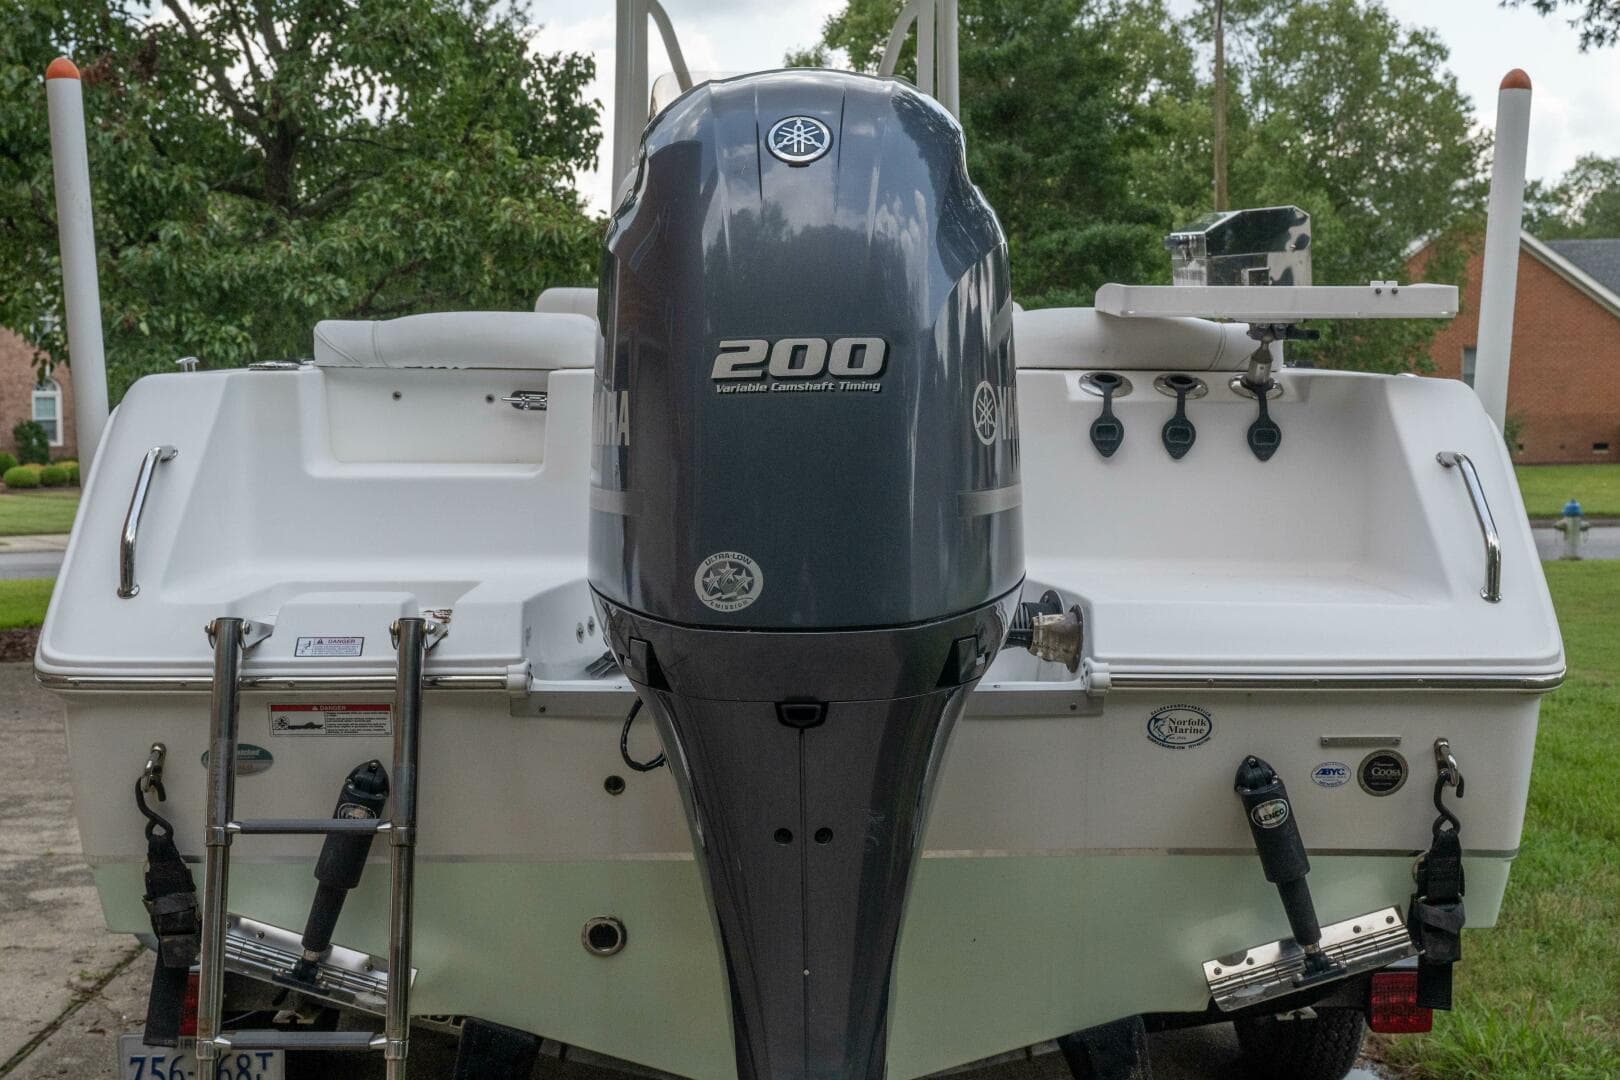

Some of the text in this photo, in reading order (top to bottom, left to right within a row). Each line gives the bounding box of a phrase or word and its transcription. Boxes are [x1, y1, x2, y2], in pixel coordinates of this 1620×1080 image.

[711, 337, 888, 380] 200
[716, 381, 881, 393] Variable Camshaft Timing
[704, 553, 752, 566] ULTRA-LOW
[1168, 718, 1207, 727] Norfolk
[1167, 726, 1205, 734] Marine
[1315, 768, 1345, 776] ABYC
